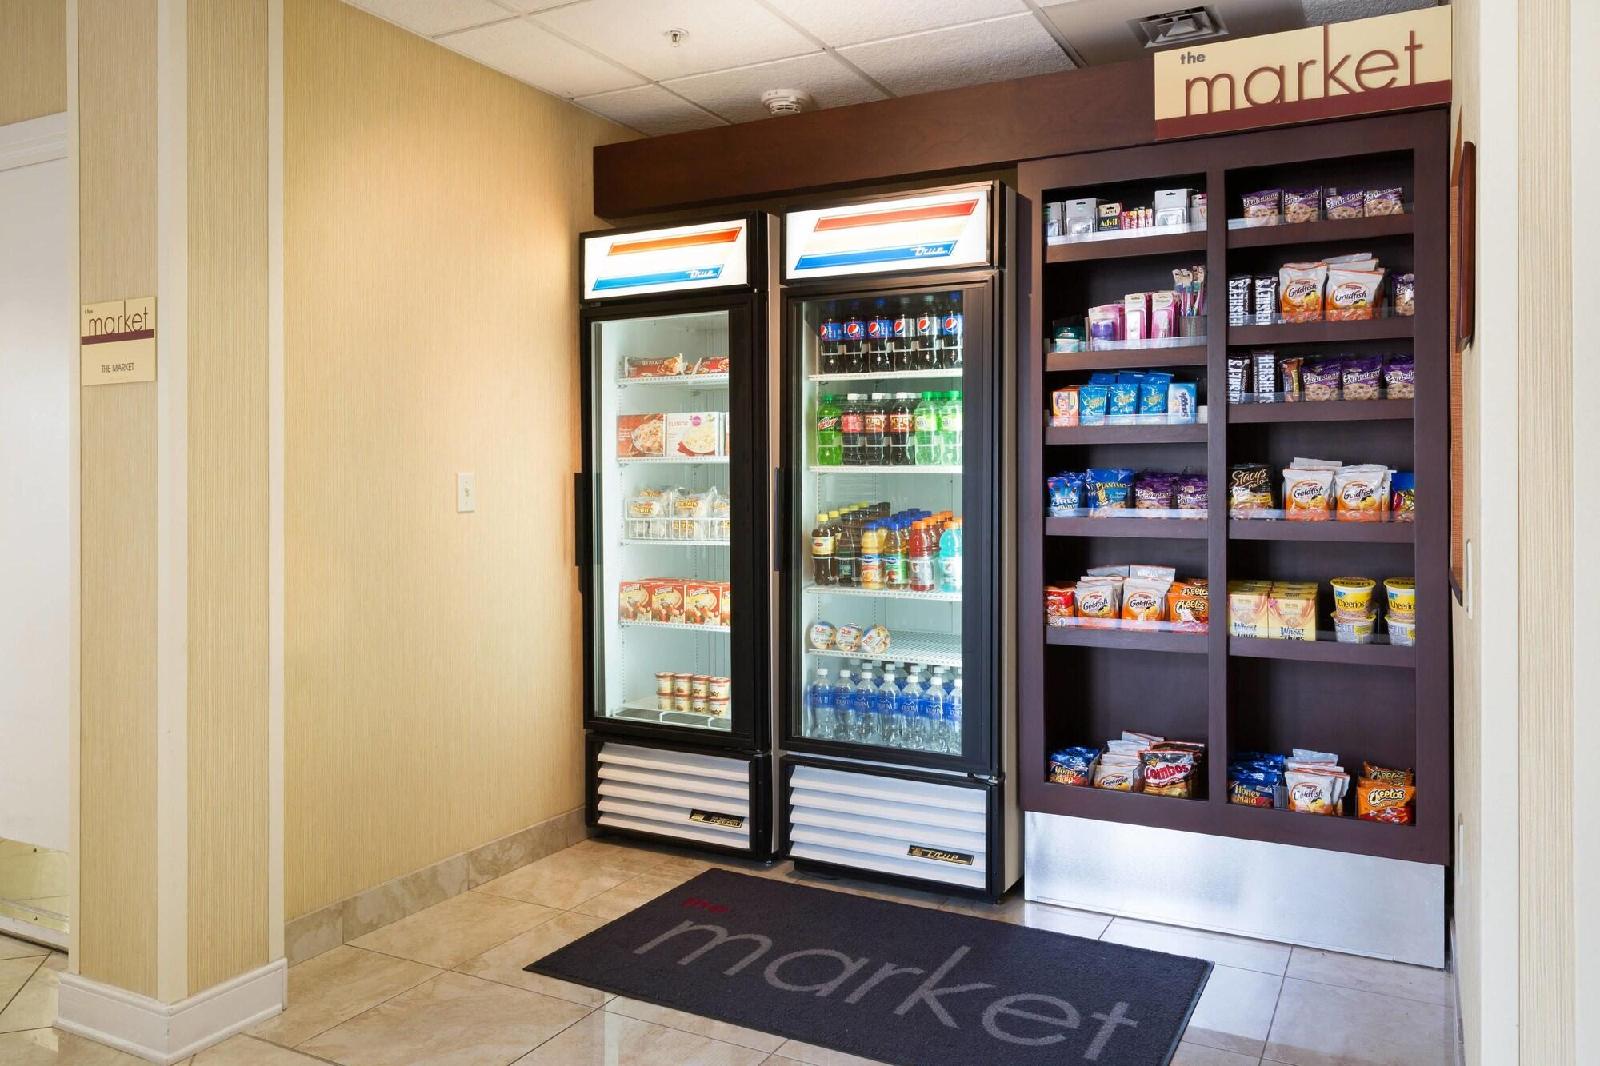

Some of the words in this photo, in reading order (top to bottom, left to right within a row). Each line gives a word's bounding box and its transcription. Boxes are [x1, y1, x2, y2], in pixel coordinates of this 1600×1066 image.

[1180, 51, 1206, 64] the
[1185, 23, 1423, 117] market
[88, 300, 148, 336] market
[101, 364, 111, 373] THE
[112, 362, 134, 372] MARKET
[1231, 468, 1267, 487] Stacy's
[1145, 764, 1190, 780] Combos
[1368, 788, 1406, 807] Cheetos
[633, 919, 1139, 1062] market
